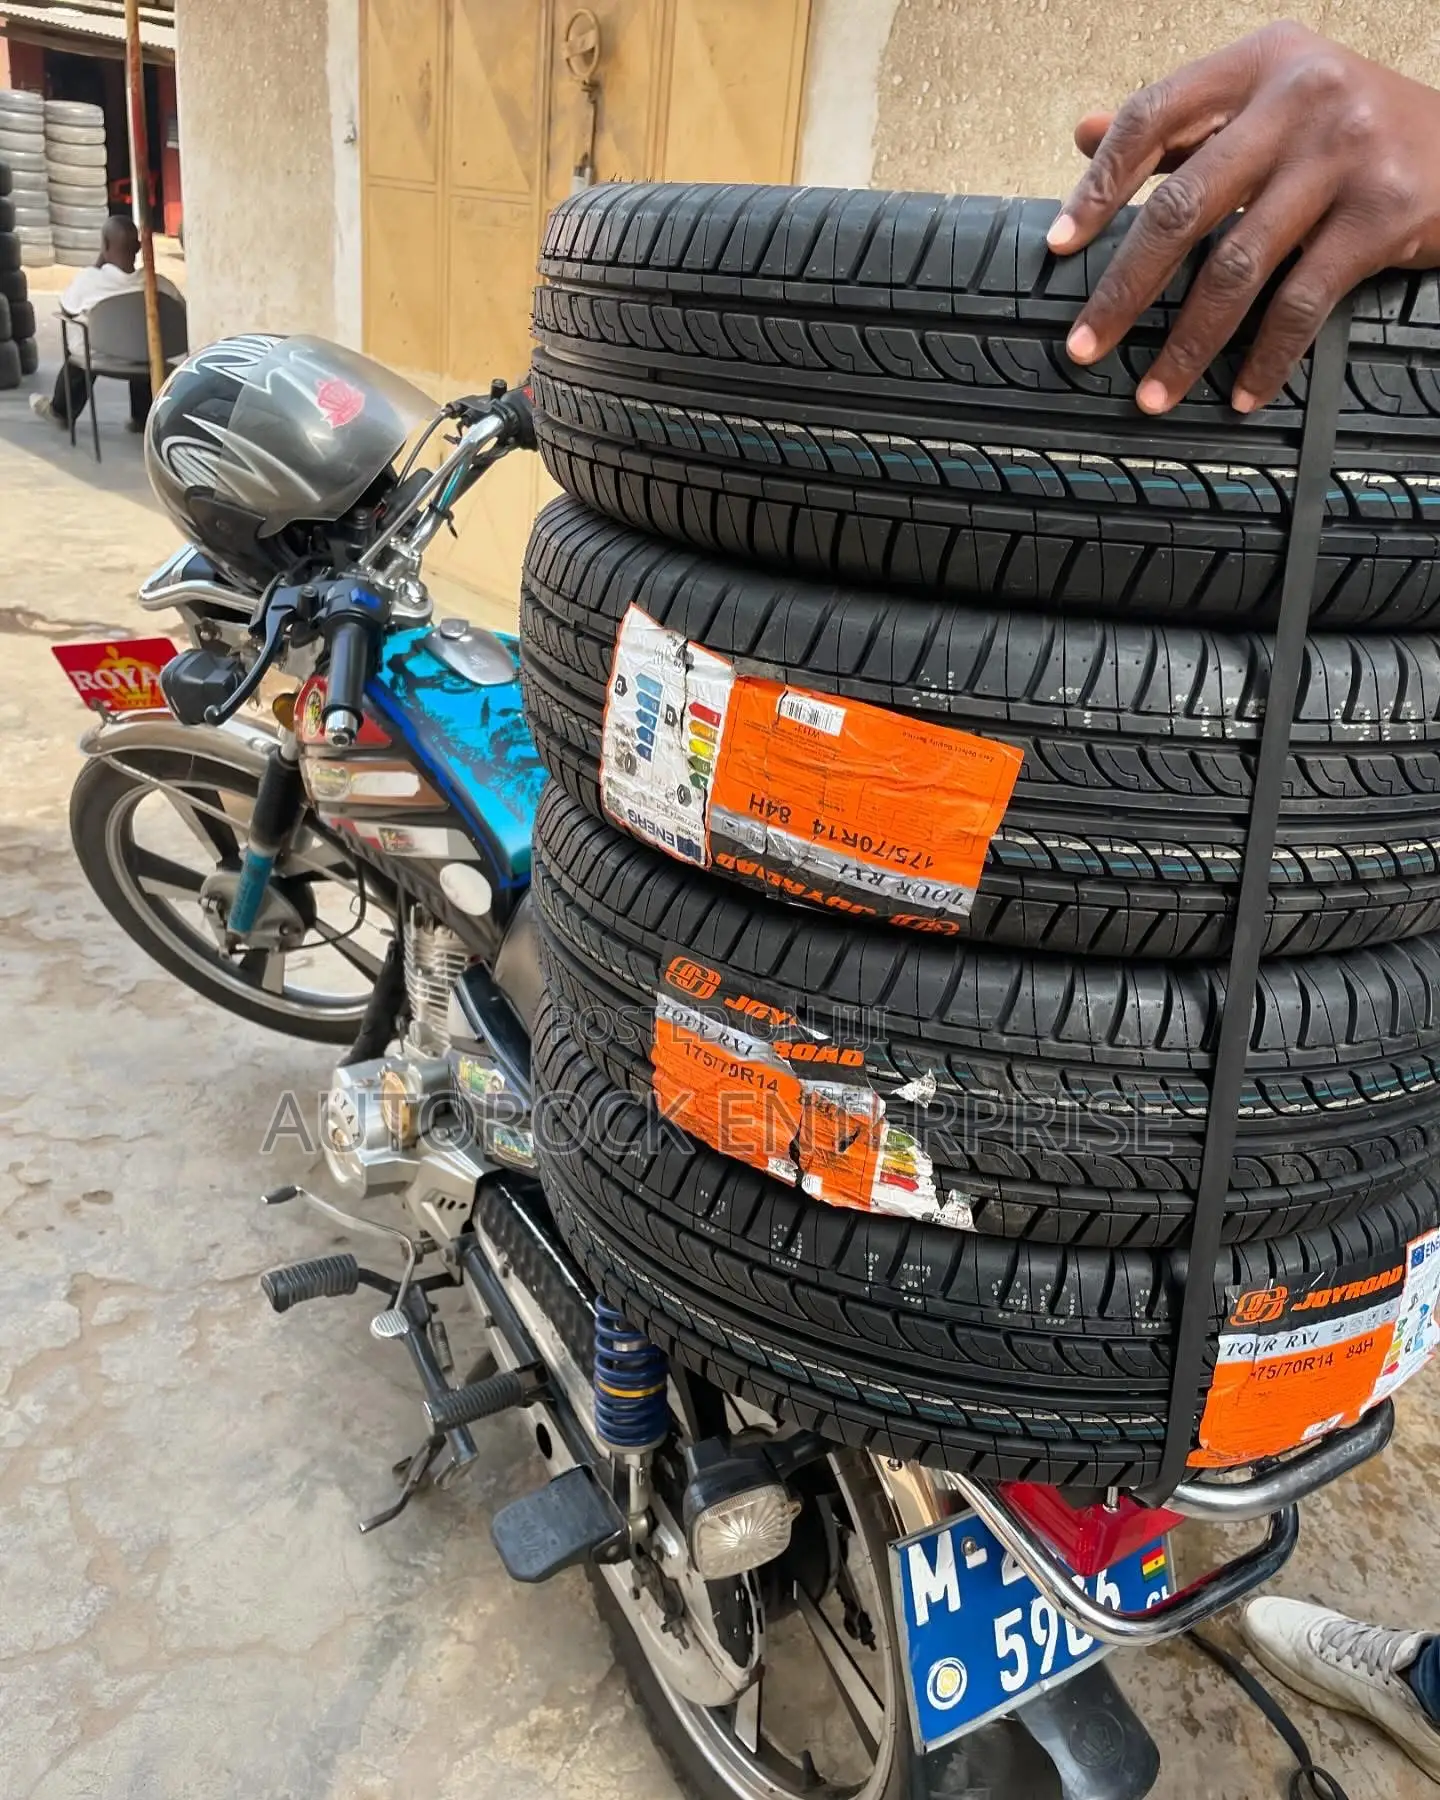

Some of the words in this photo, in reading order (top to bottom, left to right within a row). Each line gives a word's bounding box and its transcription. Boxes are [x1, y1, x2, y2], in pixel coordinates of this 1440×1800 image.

[748, 791, 794, 824] 84H
[812, 816, 935, 870] 175/70R14
[897, 880, 964, 909] TOUR
[1291, 1265, 1403, 1312] JOYROAD
[1345, 1337, 1375, 1360] 84H
